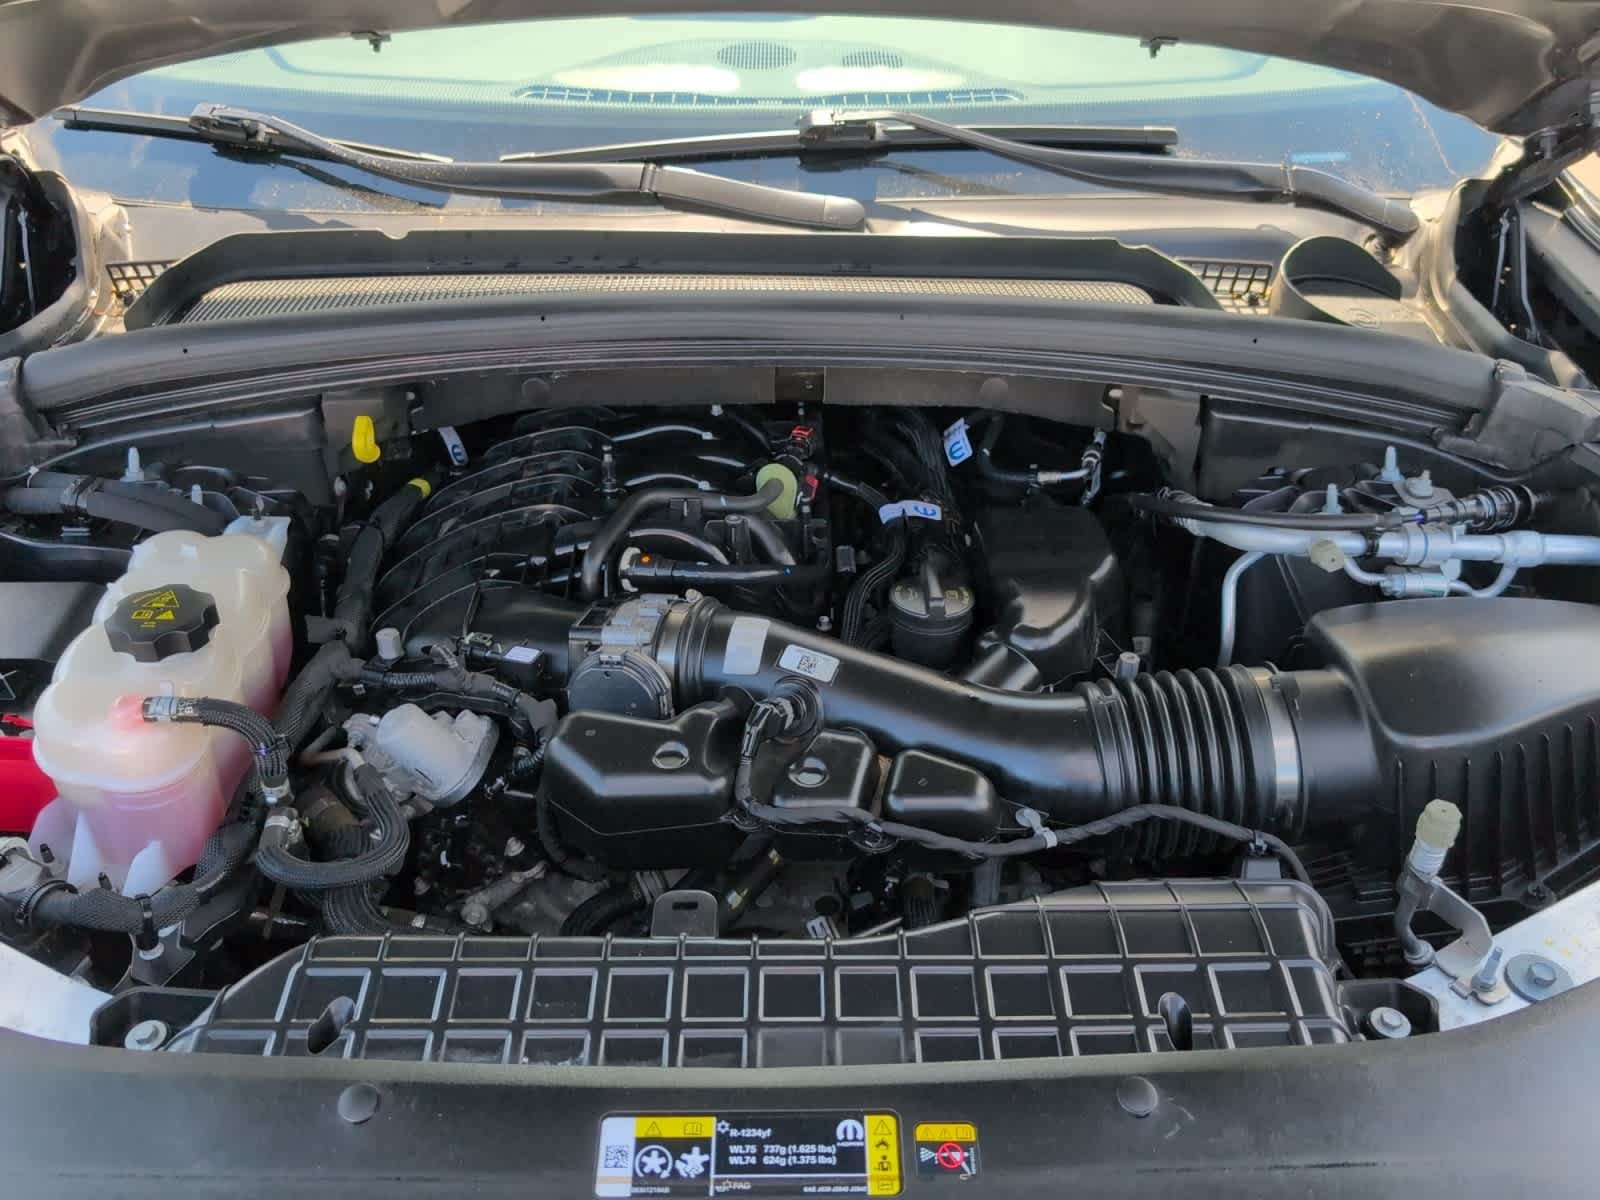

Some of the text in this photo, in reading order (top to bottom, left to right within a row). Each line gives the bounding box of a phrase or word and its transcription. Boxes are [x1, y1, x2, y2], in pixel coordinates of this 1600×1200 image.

[729, 1127, 772, 1139] R-1234yf
[729, 1144, 837, 1156] WL75 737g (1.625 lbs)
[728, 1155, 837, 1166] WL74 624g (1.375 lbs)
